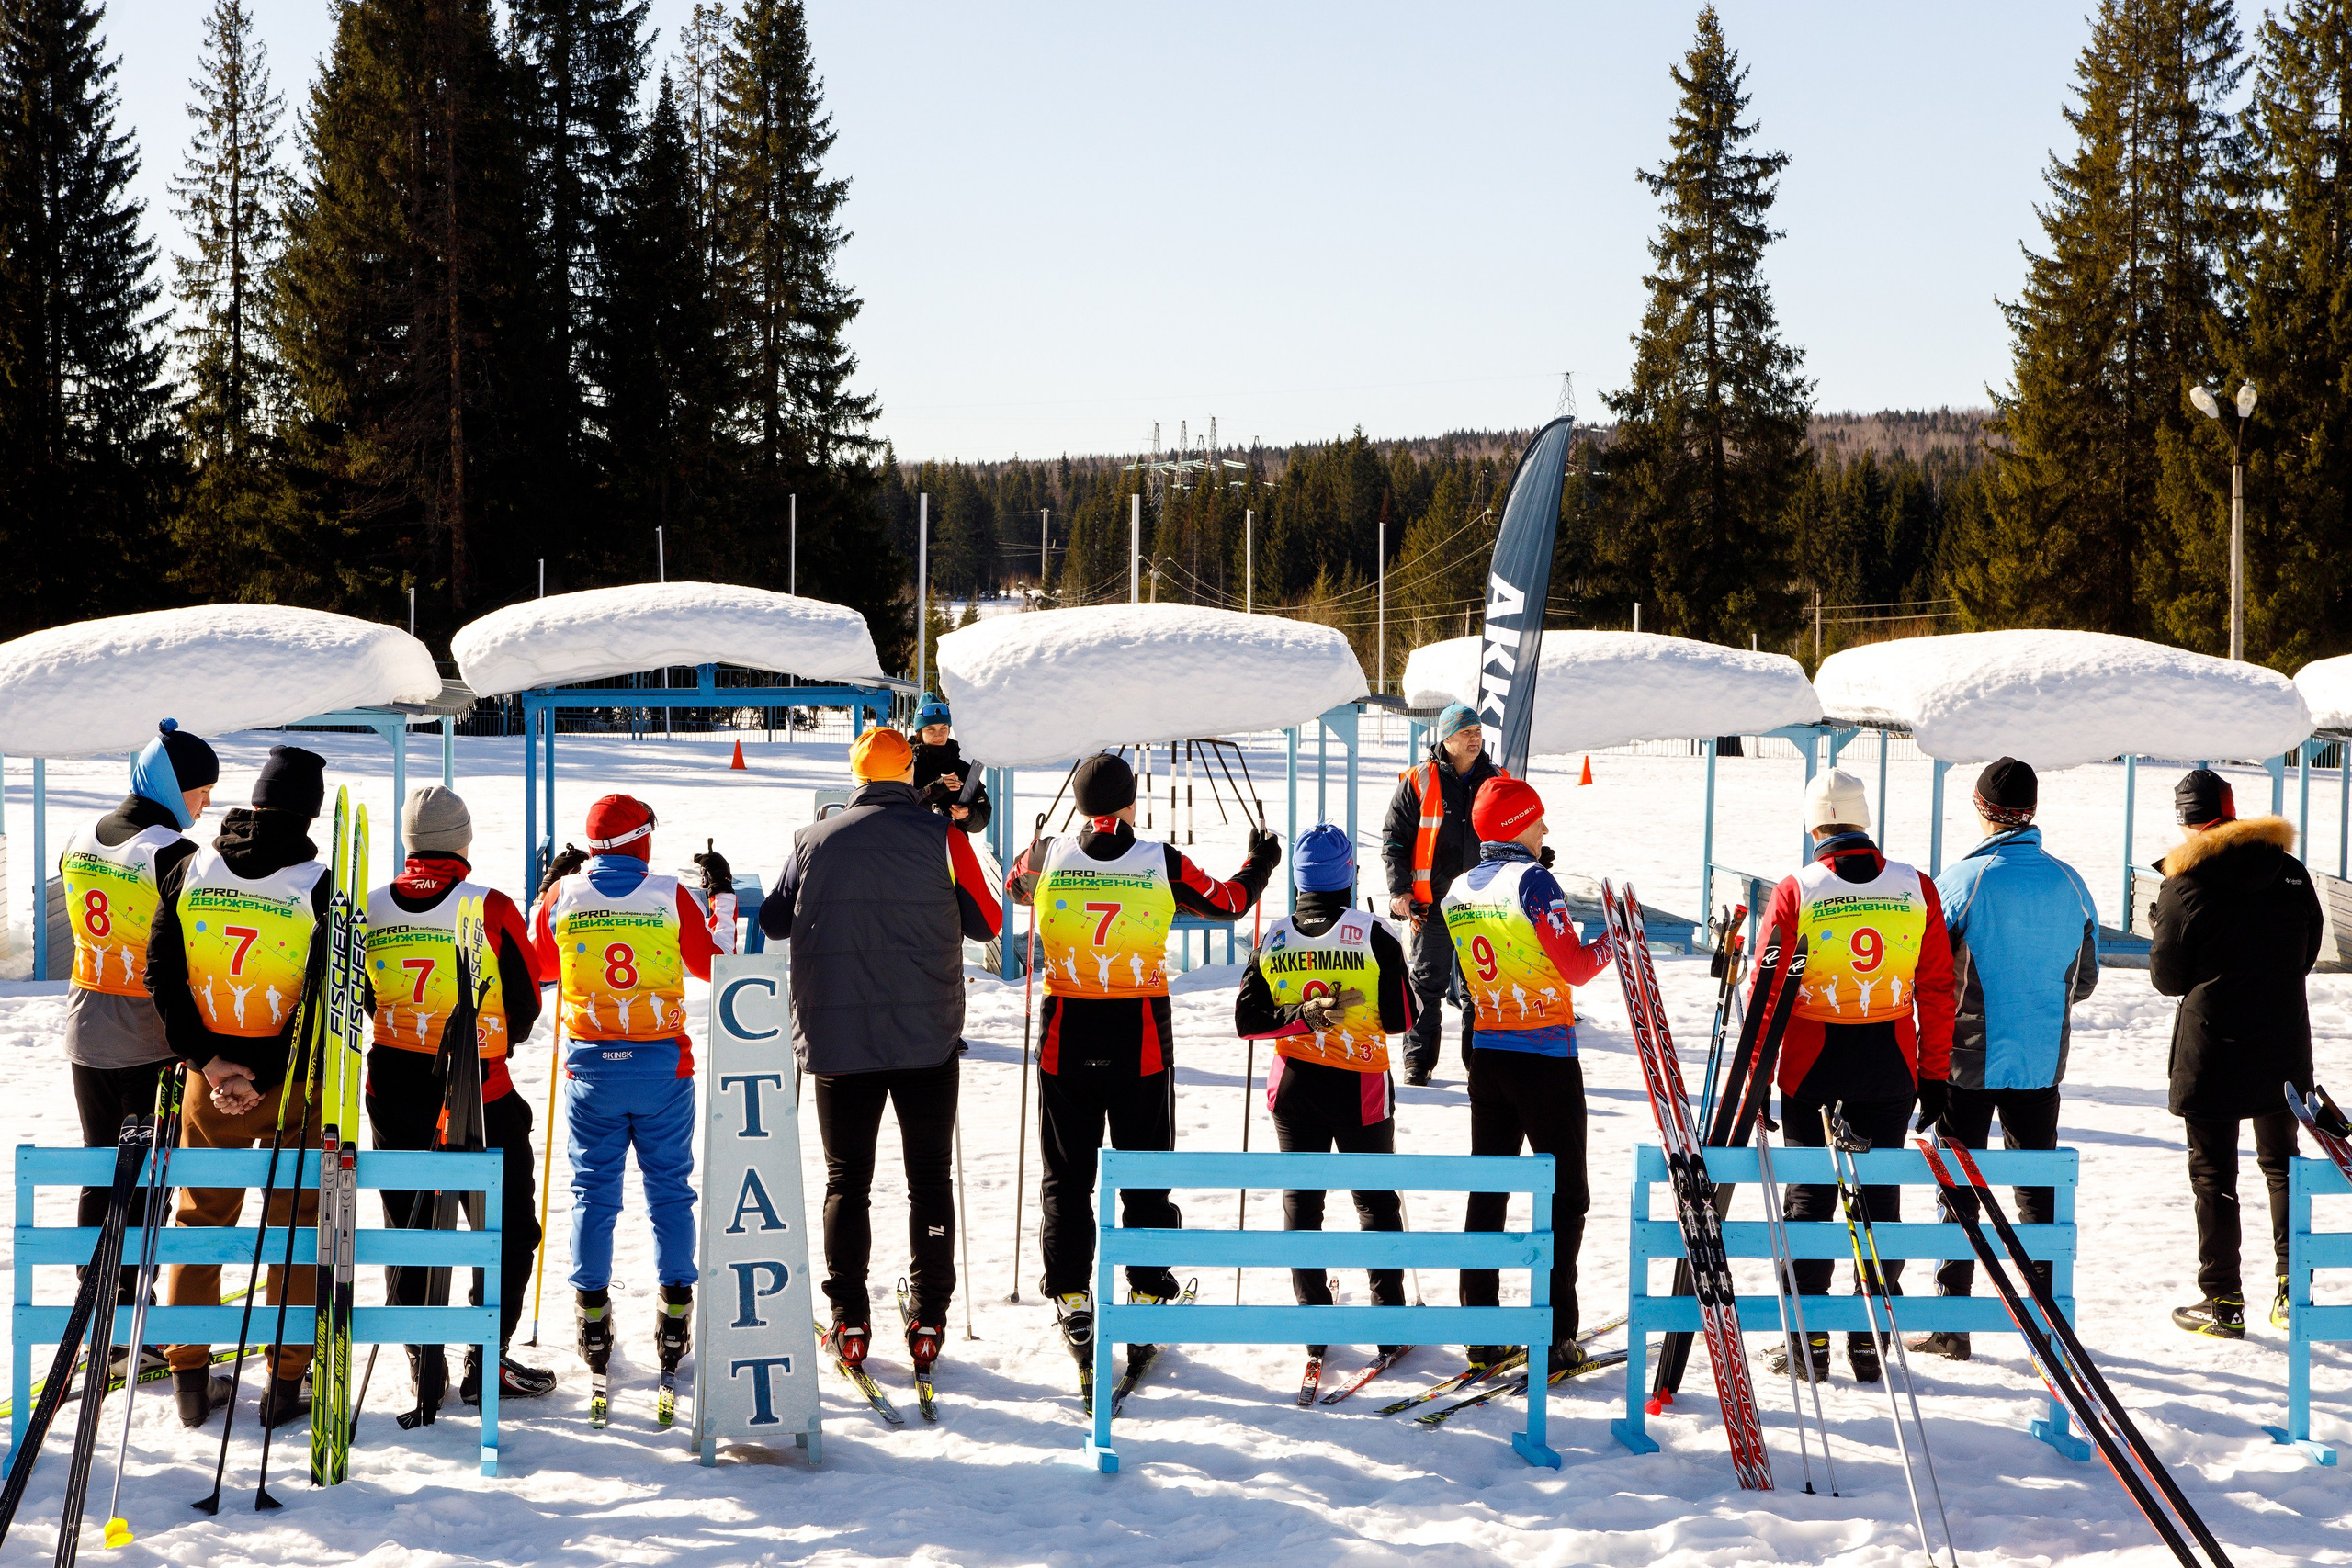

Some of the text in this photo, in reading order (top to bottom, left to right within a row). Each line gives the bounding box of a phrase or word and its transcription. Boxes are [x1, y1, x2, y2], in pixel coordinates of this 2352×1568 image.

[1500, 804, 1536, 827] NORDSKI
[191, 887, 239, 898] #PRO
[411, 879, 438, 889] RAY
[1049, 869, 1095, 878] #PRO
[85, 888, 111, 938] 8
[567, 909, 610, 921] #PRO
[1085, 901, 1122, 947] 7
[1812, 896, 1857, 909] #PRO
[224, 925, 260, 977] 7
[368, 924, 410, 938] #PRO
[1340, 924, 1363, 941] ГТО
[1849, 926, 1884, 974] 9
[329, 909, 347, 1038] FISCHER
[470, 917, 485, 992] FISCHER
[604, 942, 639, 991] 8
[1270, 950, 1365, 975] AKKERMANN
[1471, 934, 1498, 983] 9
[348, 927, 368, 1055] FISCHER
[401, 958, 435, 1005] 7
[1147, 969, 1160, 987] 4
[668, 1009, 680, 1029] 2
[1532, 998, 1546, 1018] 1
[1612, 921, 1668, 1103] MADSHUS
[1634, 927, 1688, 1103] MADSHUS
[477, 1028, 488, 1048] 2
[602, 1051, 633, 1060] SKINSK
[1359, 1043, 1374, 1063] 3
[716, 974, 794, 1427] СТАРТ
[316, 1315, 327, 1365] SKATING
[334, 1332, 345, 1382] SKATING
[1703, 1306, 1749, 1470] MADSHUS
[1722, 1305, 1766, 1470] MADSHUS
